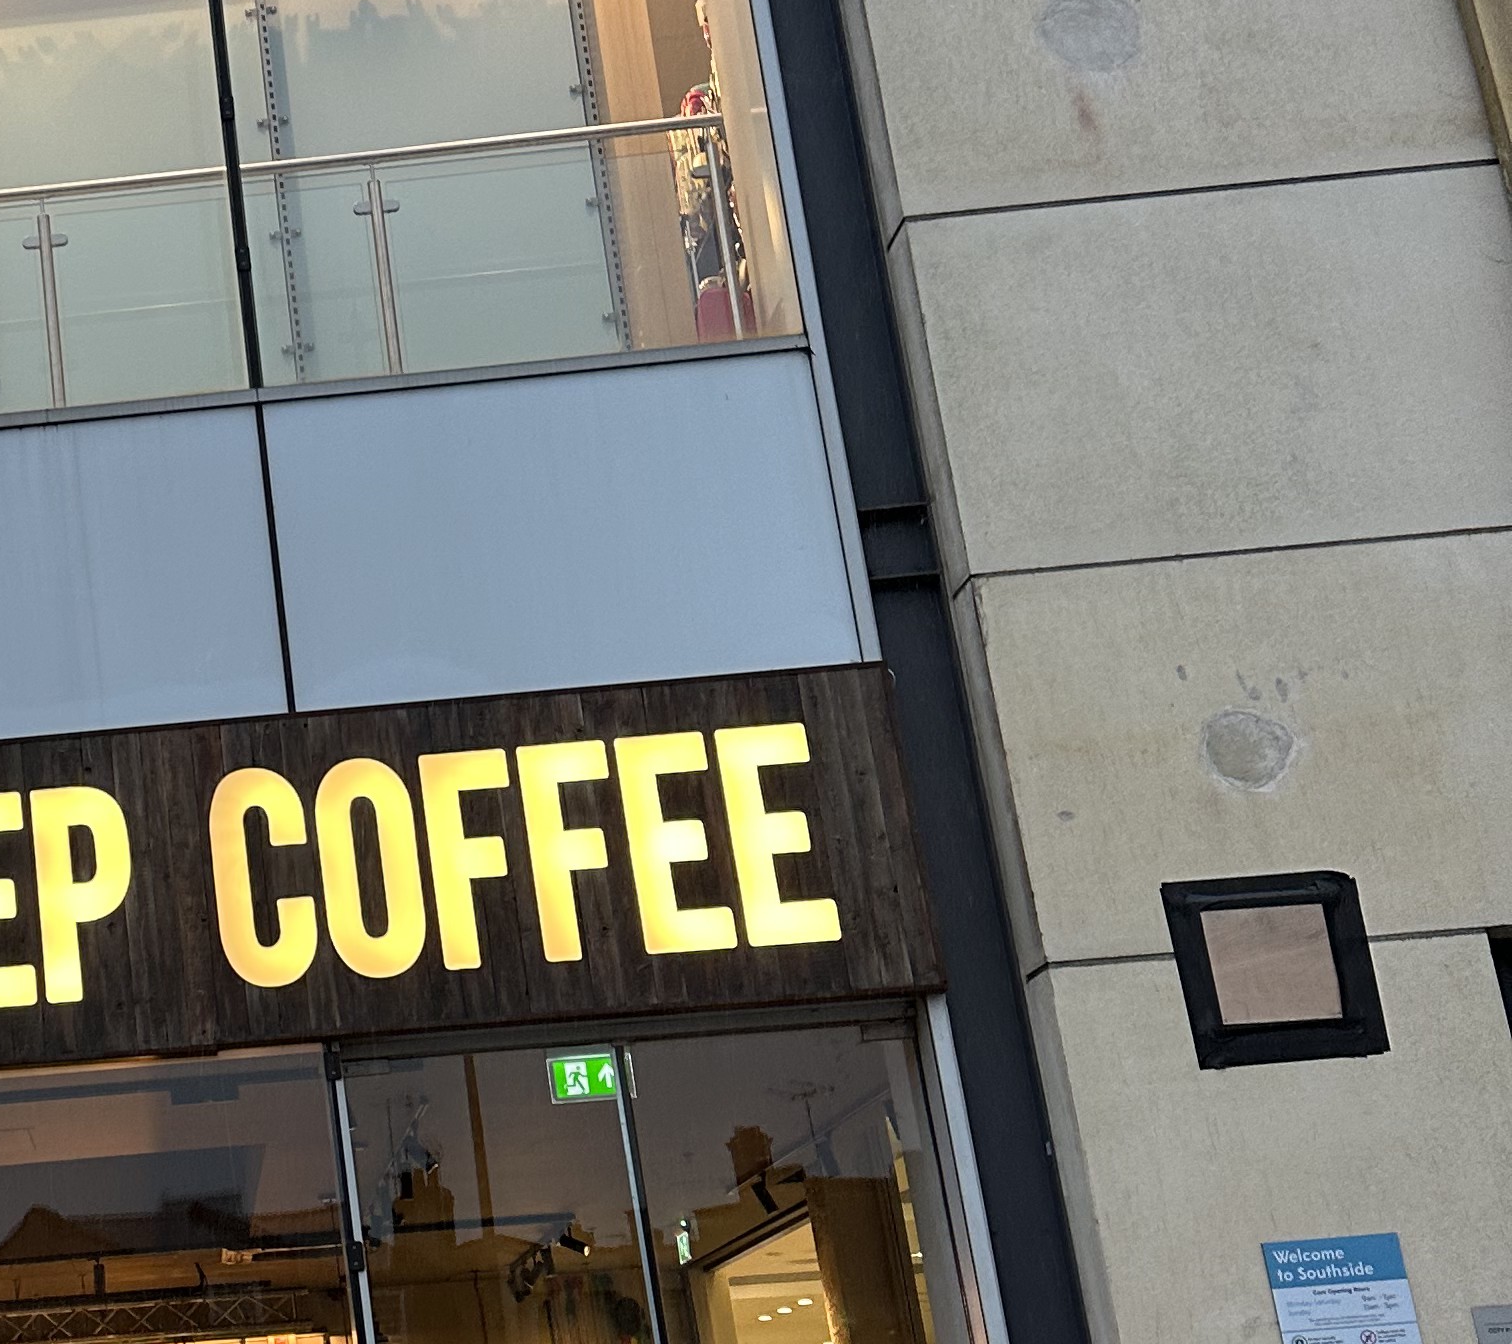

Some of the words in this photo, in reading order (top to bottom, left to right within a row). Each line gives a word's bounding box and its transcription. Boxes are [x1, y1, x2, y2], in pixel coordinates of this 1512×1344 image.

[208, 722, 842, 988] COFFEE
[1272, 1248, 1345, 1264] Welcome
[1277, 1269, 1294, 1282] to
[1297, 1261, 1374, 1280] Southside
